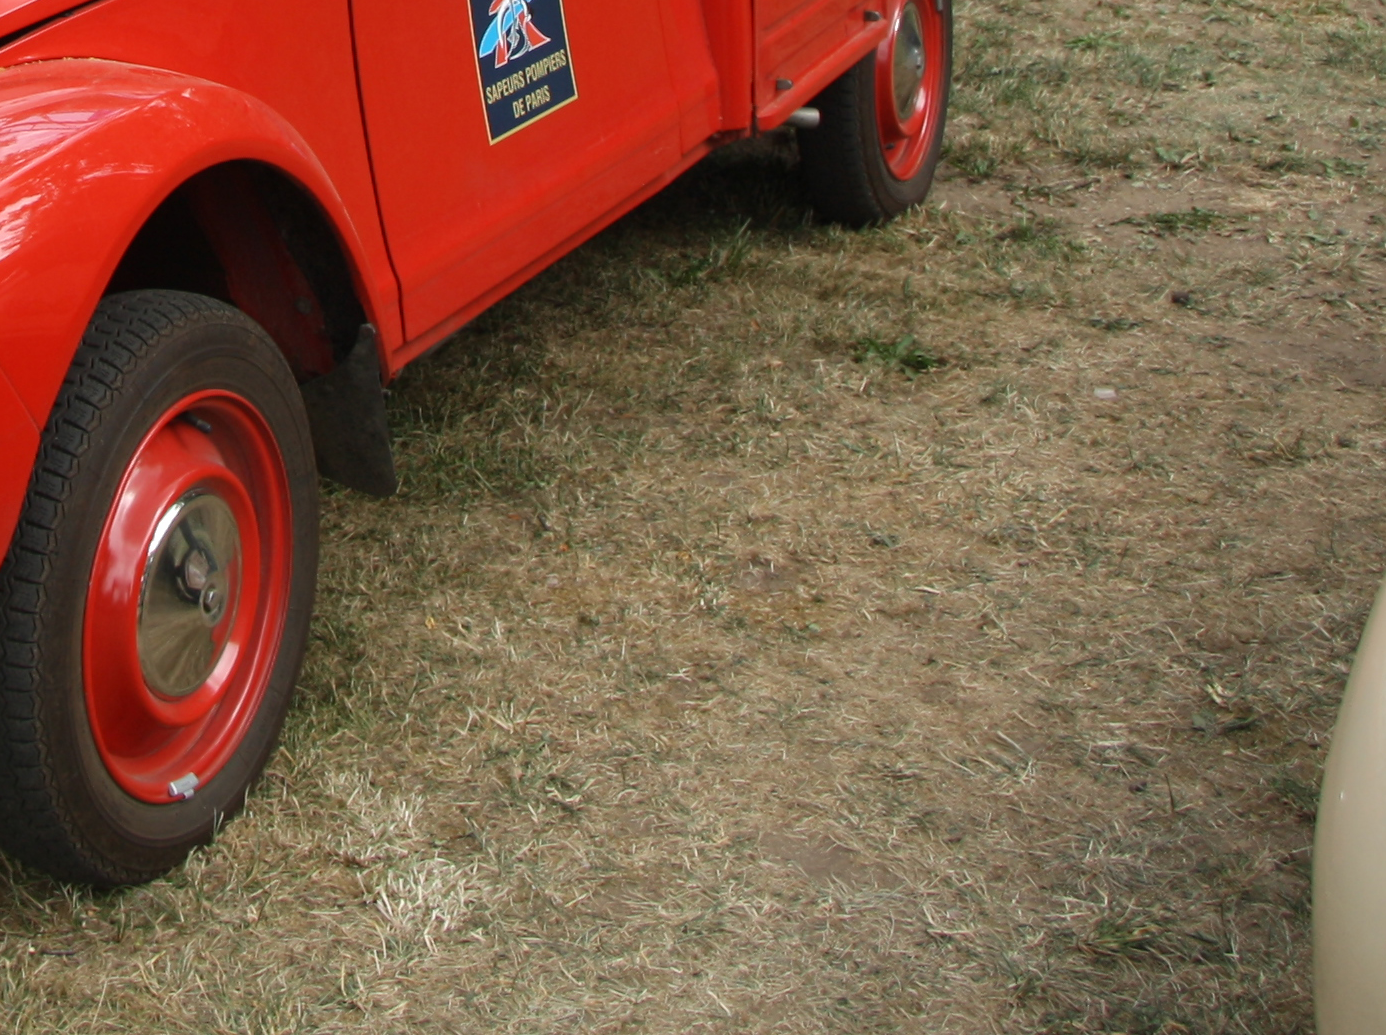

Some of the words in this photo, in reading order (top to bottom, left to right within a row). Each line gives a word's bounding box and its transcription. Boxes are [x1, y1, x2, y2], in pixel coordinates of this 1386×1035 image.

[486, 70, 526, 105] SAPEURS
[525, 49, 567, 83] POMPIERS
[512, 98, 526, 119] DE
[525, 85, 551, 112] PARIS
